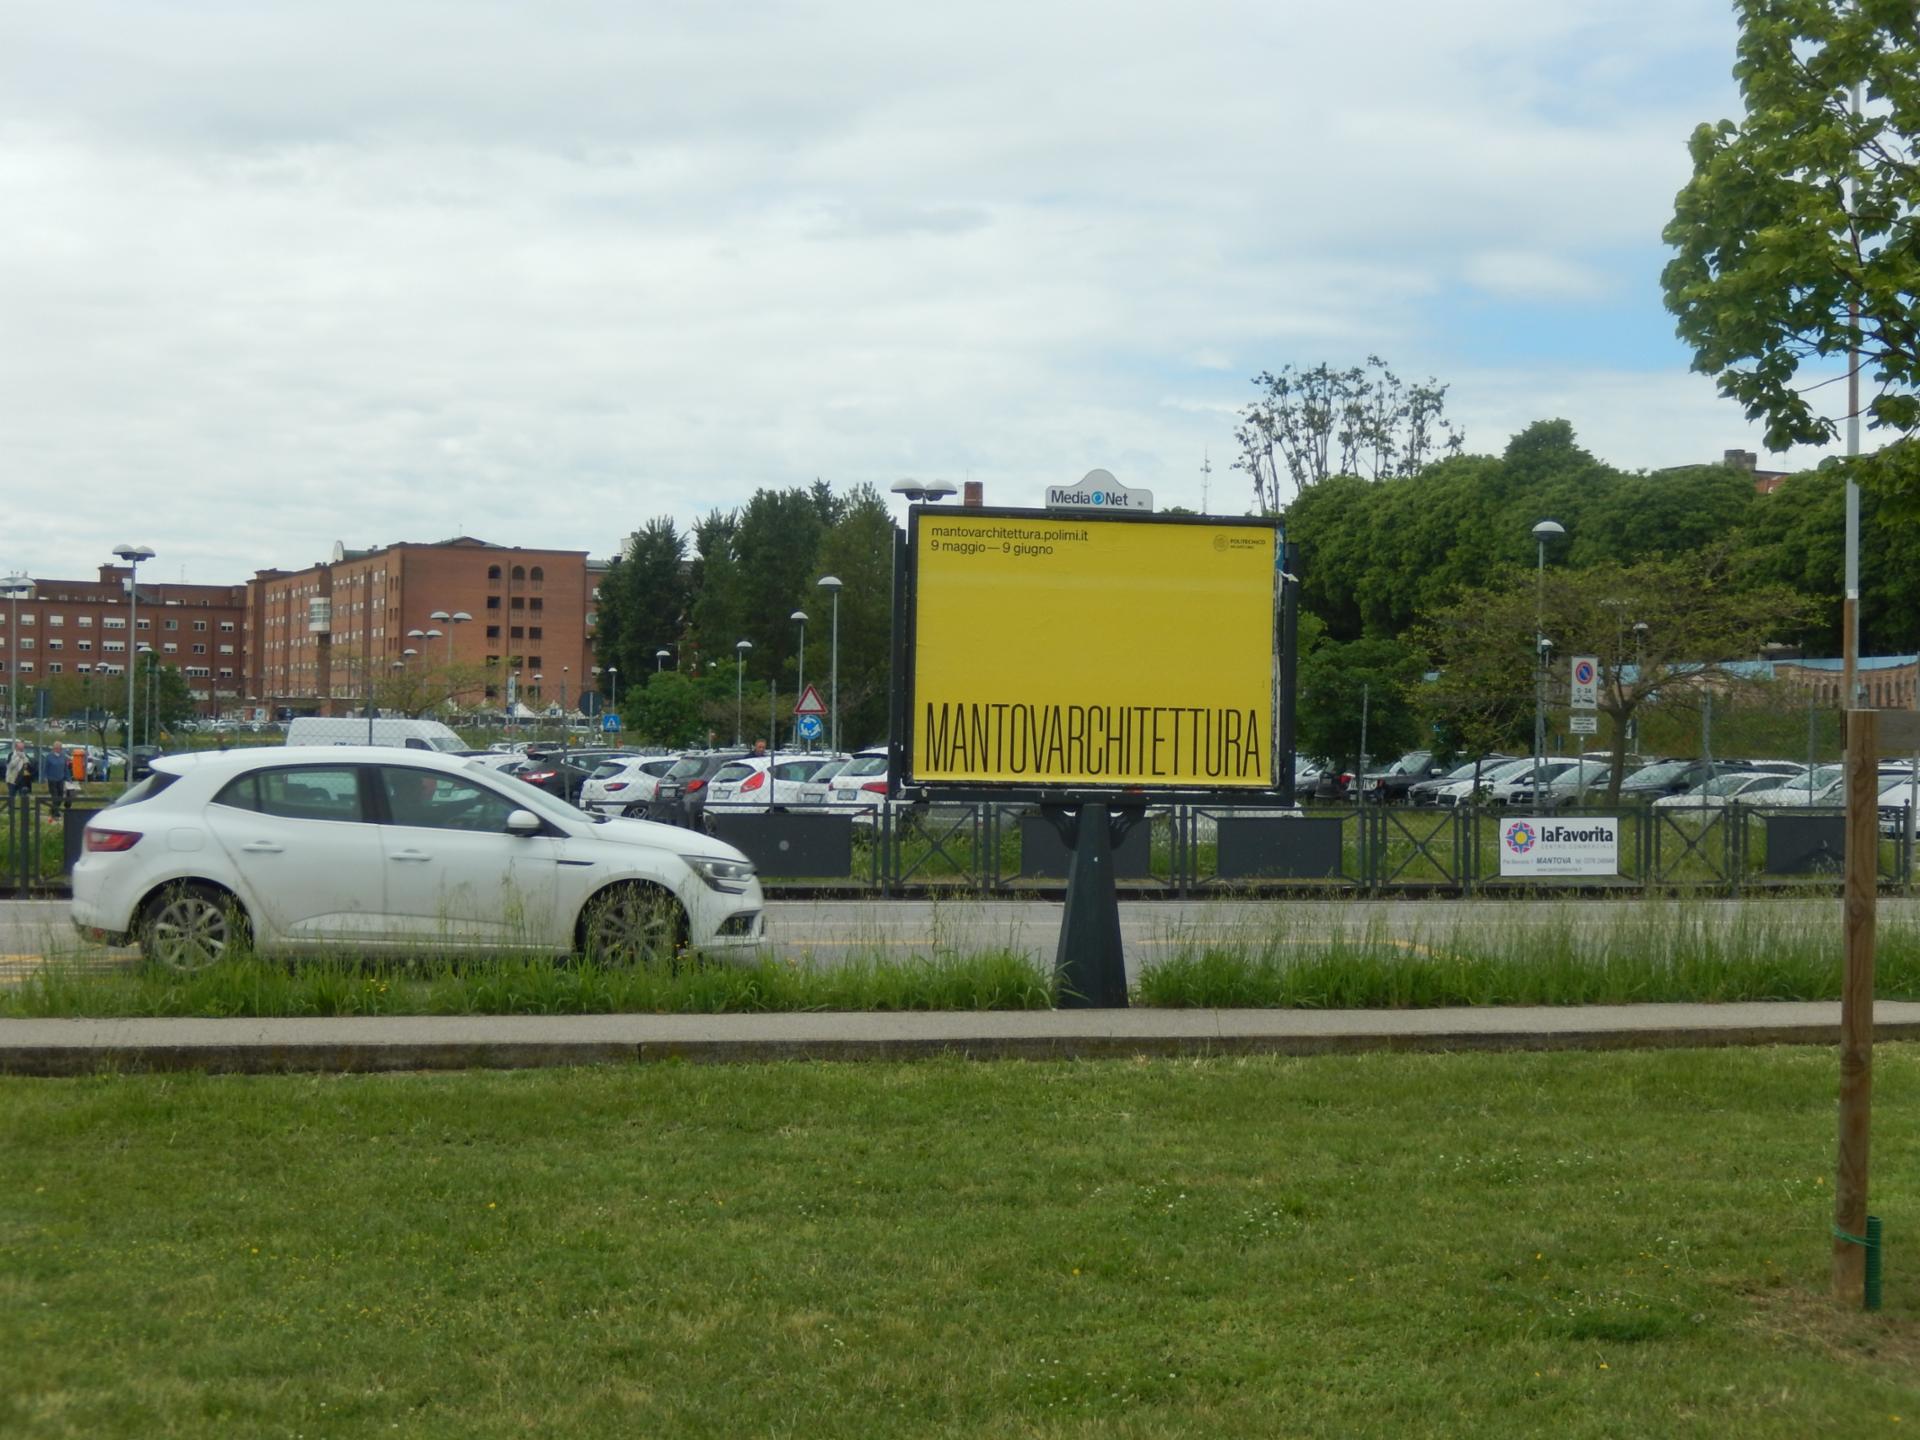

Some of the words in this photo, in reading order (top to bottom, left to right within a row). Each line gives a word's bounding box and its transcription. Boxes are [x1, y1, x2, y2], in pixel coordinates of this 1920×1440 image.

[1051, 490, 1091, 504] Media
[1105, 492, 1128, 506] Net
[931, 526, 1088, 542] mantovarchitettura.polimi.it
[931, 539, 939, 551] 9
[942, 541, 986, 555] maggio
[1002, 541, 1011, 554] 9
[1013, 543, 1053, 557] giugno
[925, 702, 1261, 777] MANTOVARCHITETTURA
[1541, 826, 1614, 842] laFavorita
[1536, 857, 1572, 865] MANTOVA
